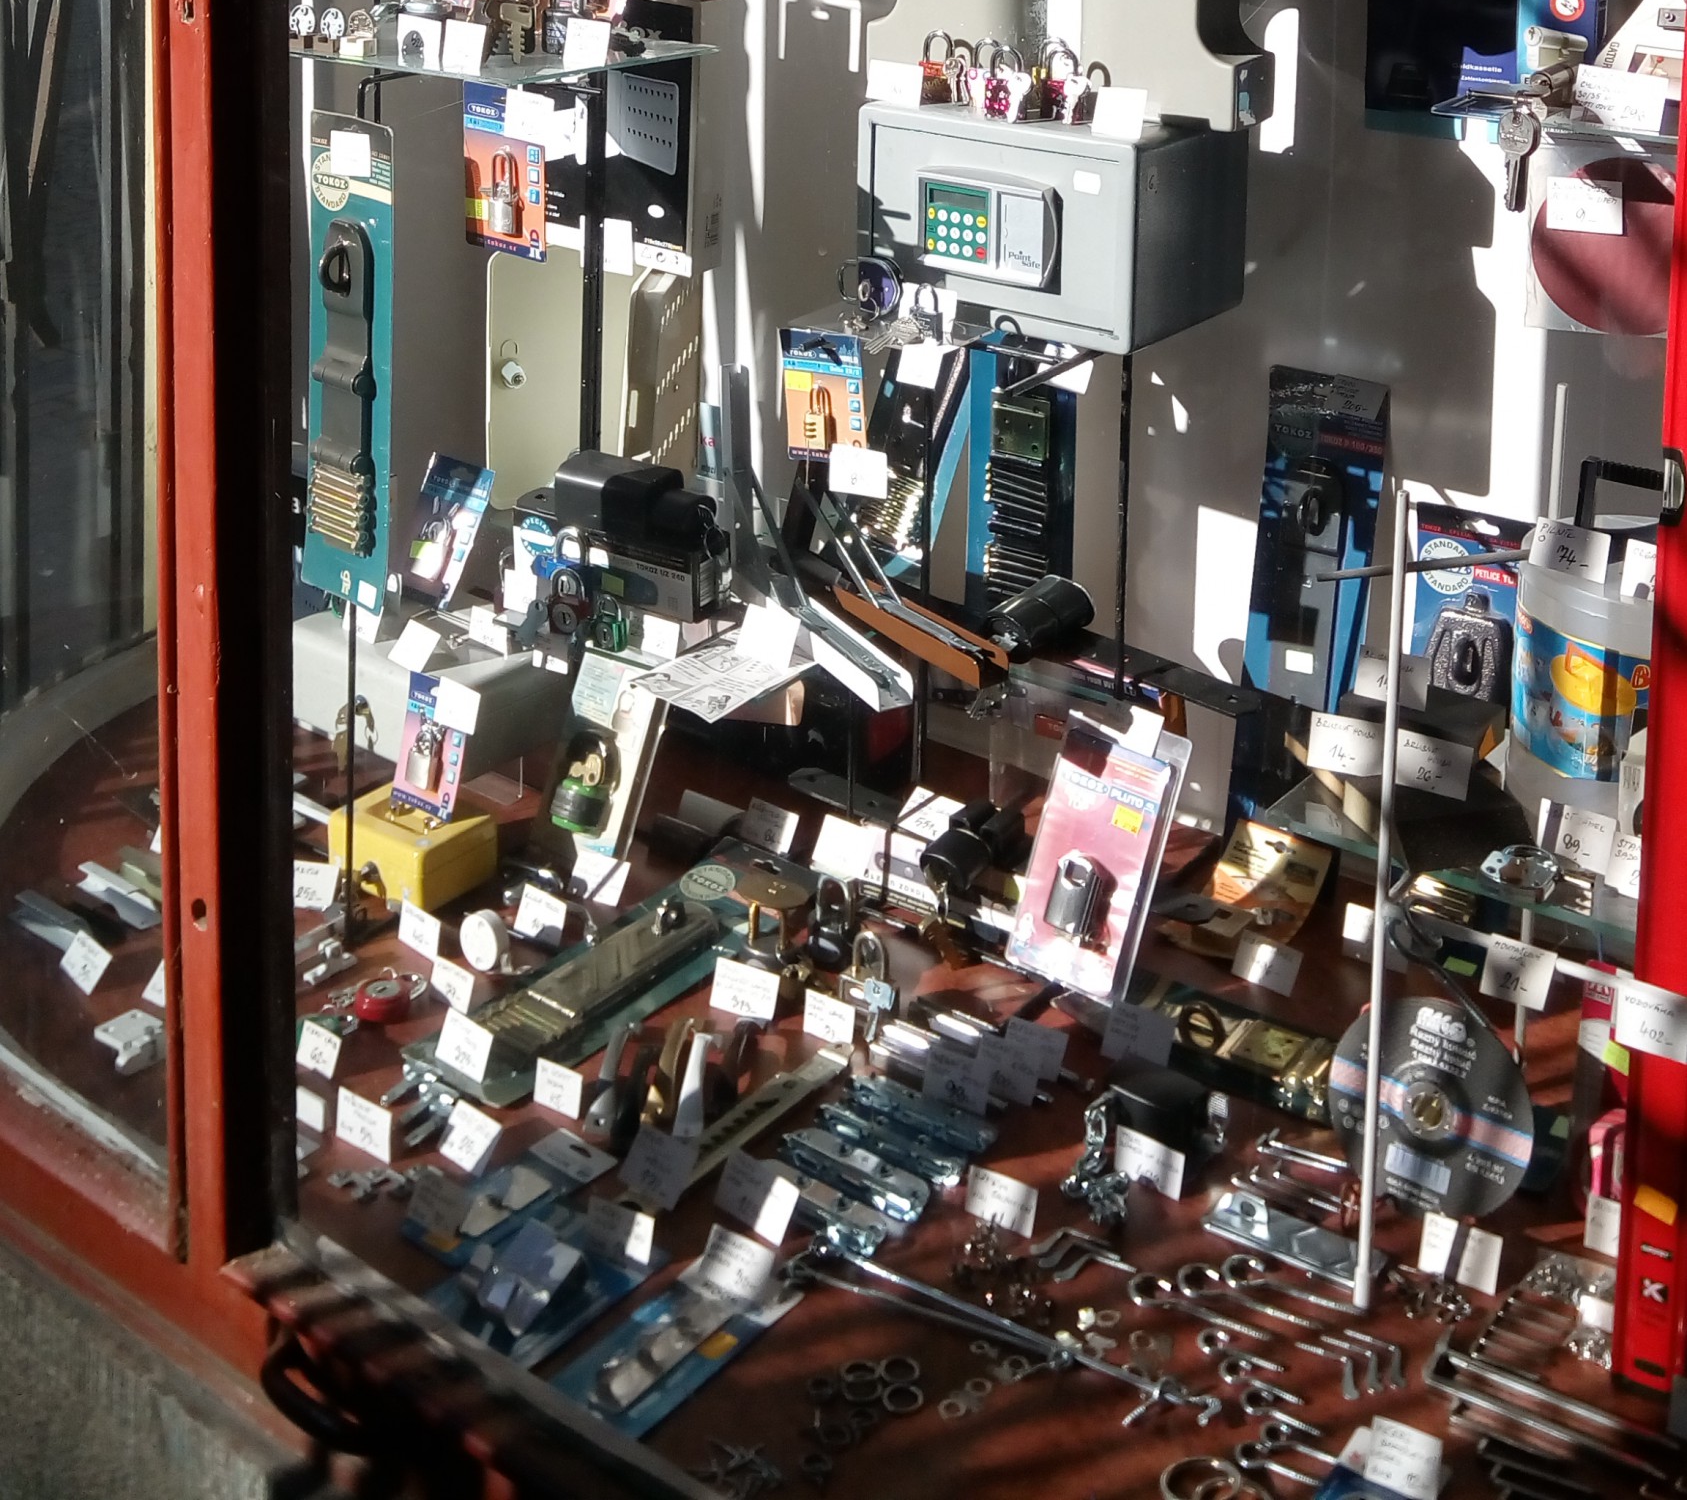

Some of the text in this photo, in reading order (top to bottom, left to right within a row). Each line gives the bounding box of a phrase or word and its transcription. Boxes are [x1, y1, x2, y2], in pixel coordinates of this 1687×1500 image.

[316, 174, 348, 190] TOKOZ
[1008, 251, 1031, 261] Point
[1274, 423, 1313, 439] TOKOZ
[1474, 567, 1501, 582] PETLICE
[1110, 786, 1144, 808] PLUTO
